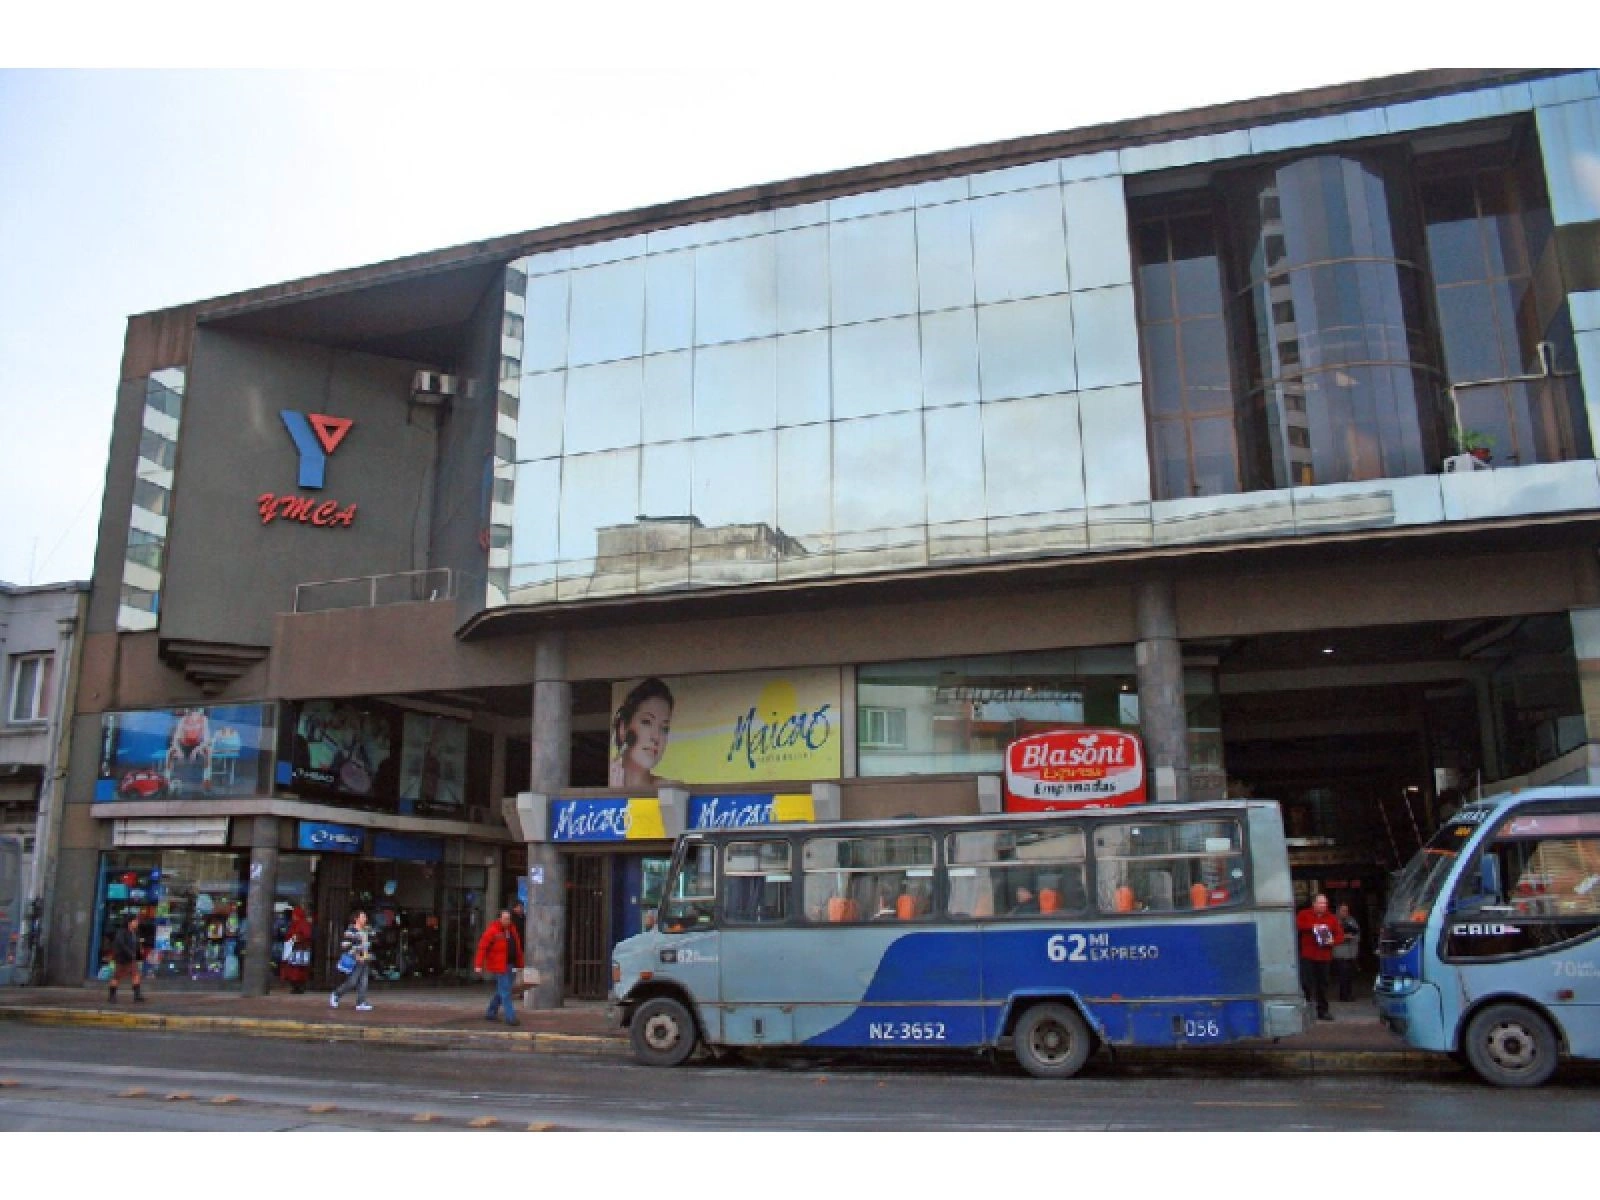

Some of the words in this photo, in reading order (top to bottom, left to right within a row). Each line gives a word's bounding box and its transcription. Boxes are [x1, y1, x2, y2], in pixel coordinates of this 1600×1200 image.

[257, 493, 357, 526] YMCA
[727, 703, 831, 768] Maicao
[1021, 736, 1124, 768] Blasoni
[1033, 779, 1116, 796] Empanadas
[553, 800, 632, 839] Maicao
[1047, 933, 1088, 961] 62
[1089, 931, 1109, 947] MI
[1089, 945, 1159, 961] EXPRESO
[1552, 961, 1577, 977] 70
[869, 1022, 946, 1040] NZ-3652
[1184, 1019, 1219, 1037] 056
